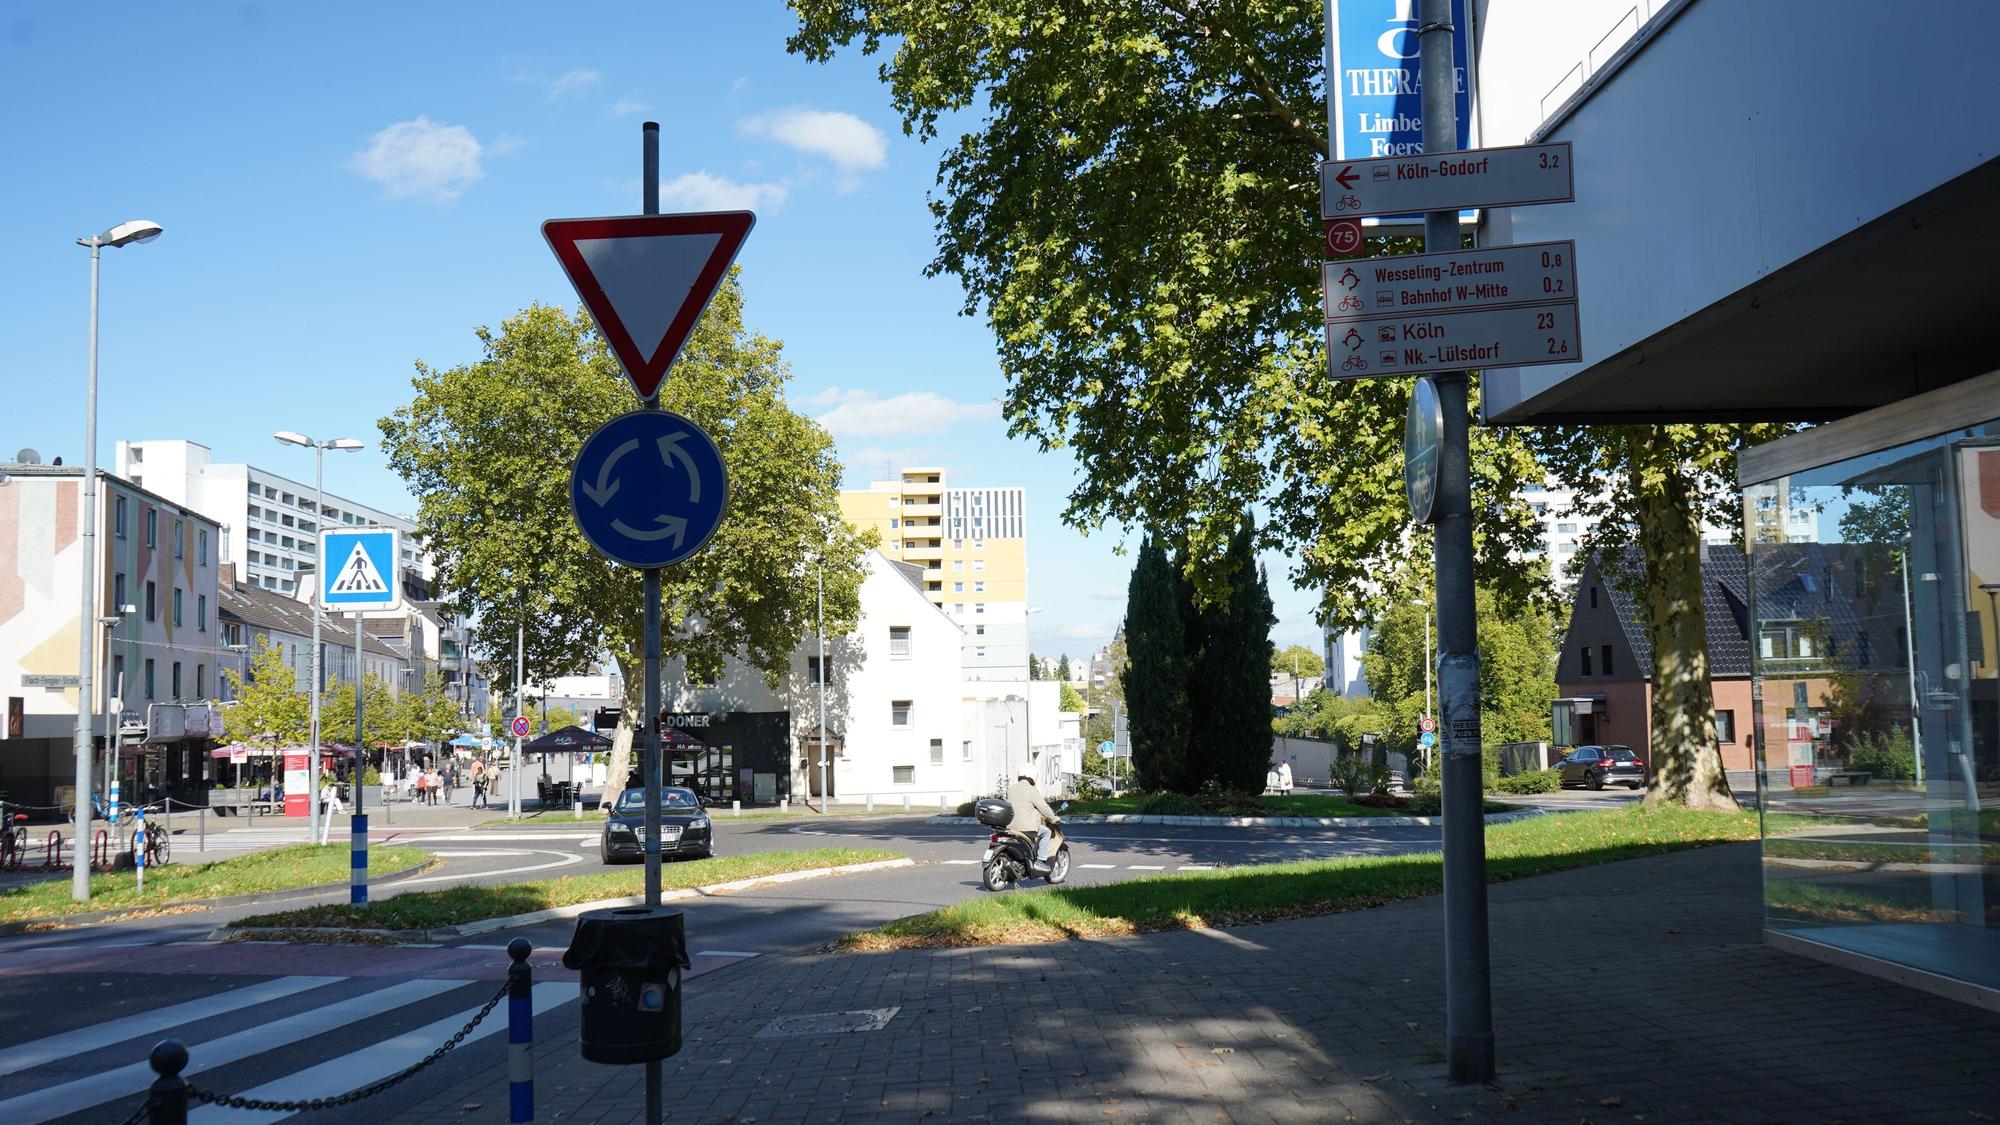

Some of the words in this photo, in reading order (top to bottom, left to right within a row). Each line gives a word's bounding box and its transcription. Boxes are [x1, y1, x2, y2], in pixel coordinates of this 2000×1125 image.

[1347, 67, 1465, 96] THERAE
[1396, 157, 1489, 181] Köln-Godorf
[1539, 152, 1560, 170] 3,2
[1334, 231, 1354, 244] 75
[1375, 260, 1505, 283] Wesseling-Zentrum
[1541, 251, 1563, 269] 0,8
[1401, 287, 1453, 306] Bahnhof
[1456, 284, 1509, 301] W-Mitte
[1543, 276, 1564, 293] 0,2
[1403, 322, 1445, 341] Köln
[1536, 312, 1554, 330] 23
[1404, 342, 1500, 366] Nk.-Lülsdorf
[1547, 337, 1568, 355] 2,6
